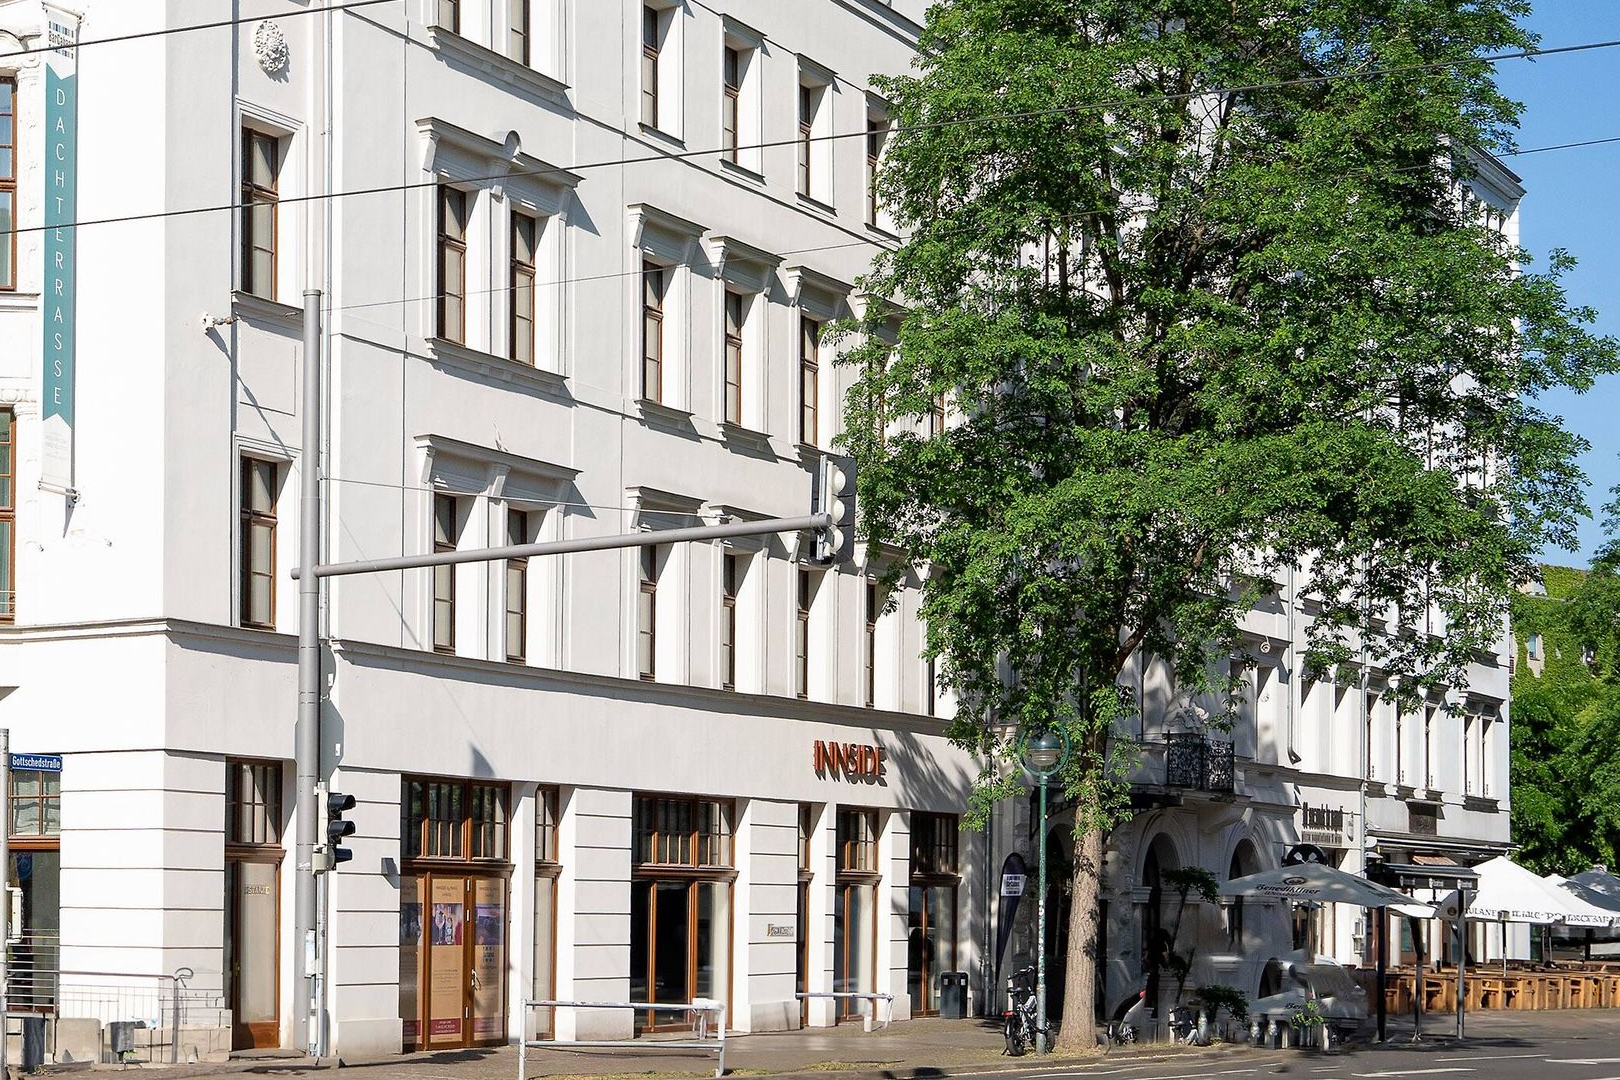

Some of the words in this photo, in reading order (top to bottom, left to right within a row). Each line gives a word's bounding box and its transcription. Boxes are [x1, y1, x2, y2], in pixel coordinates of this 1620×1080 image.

[53, 87, 66, 406] DACHTERRASSE
[12, 754, 61, 769] Gottschedstraße
[814, 739, 887, 778] INNSIDE
